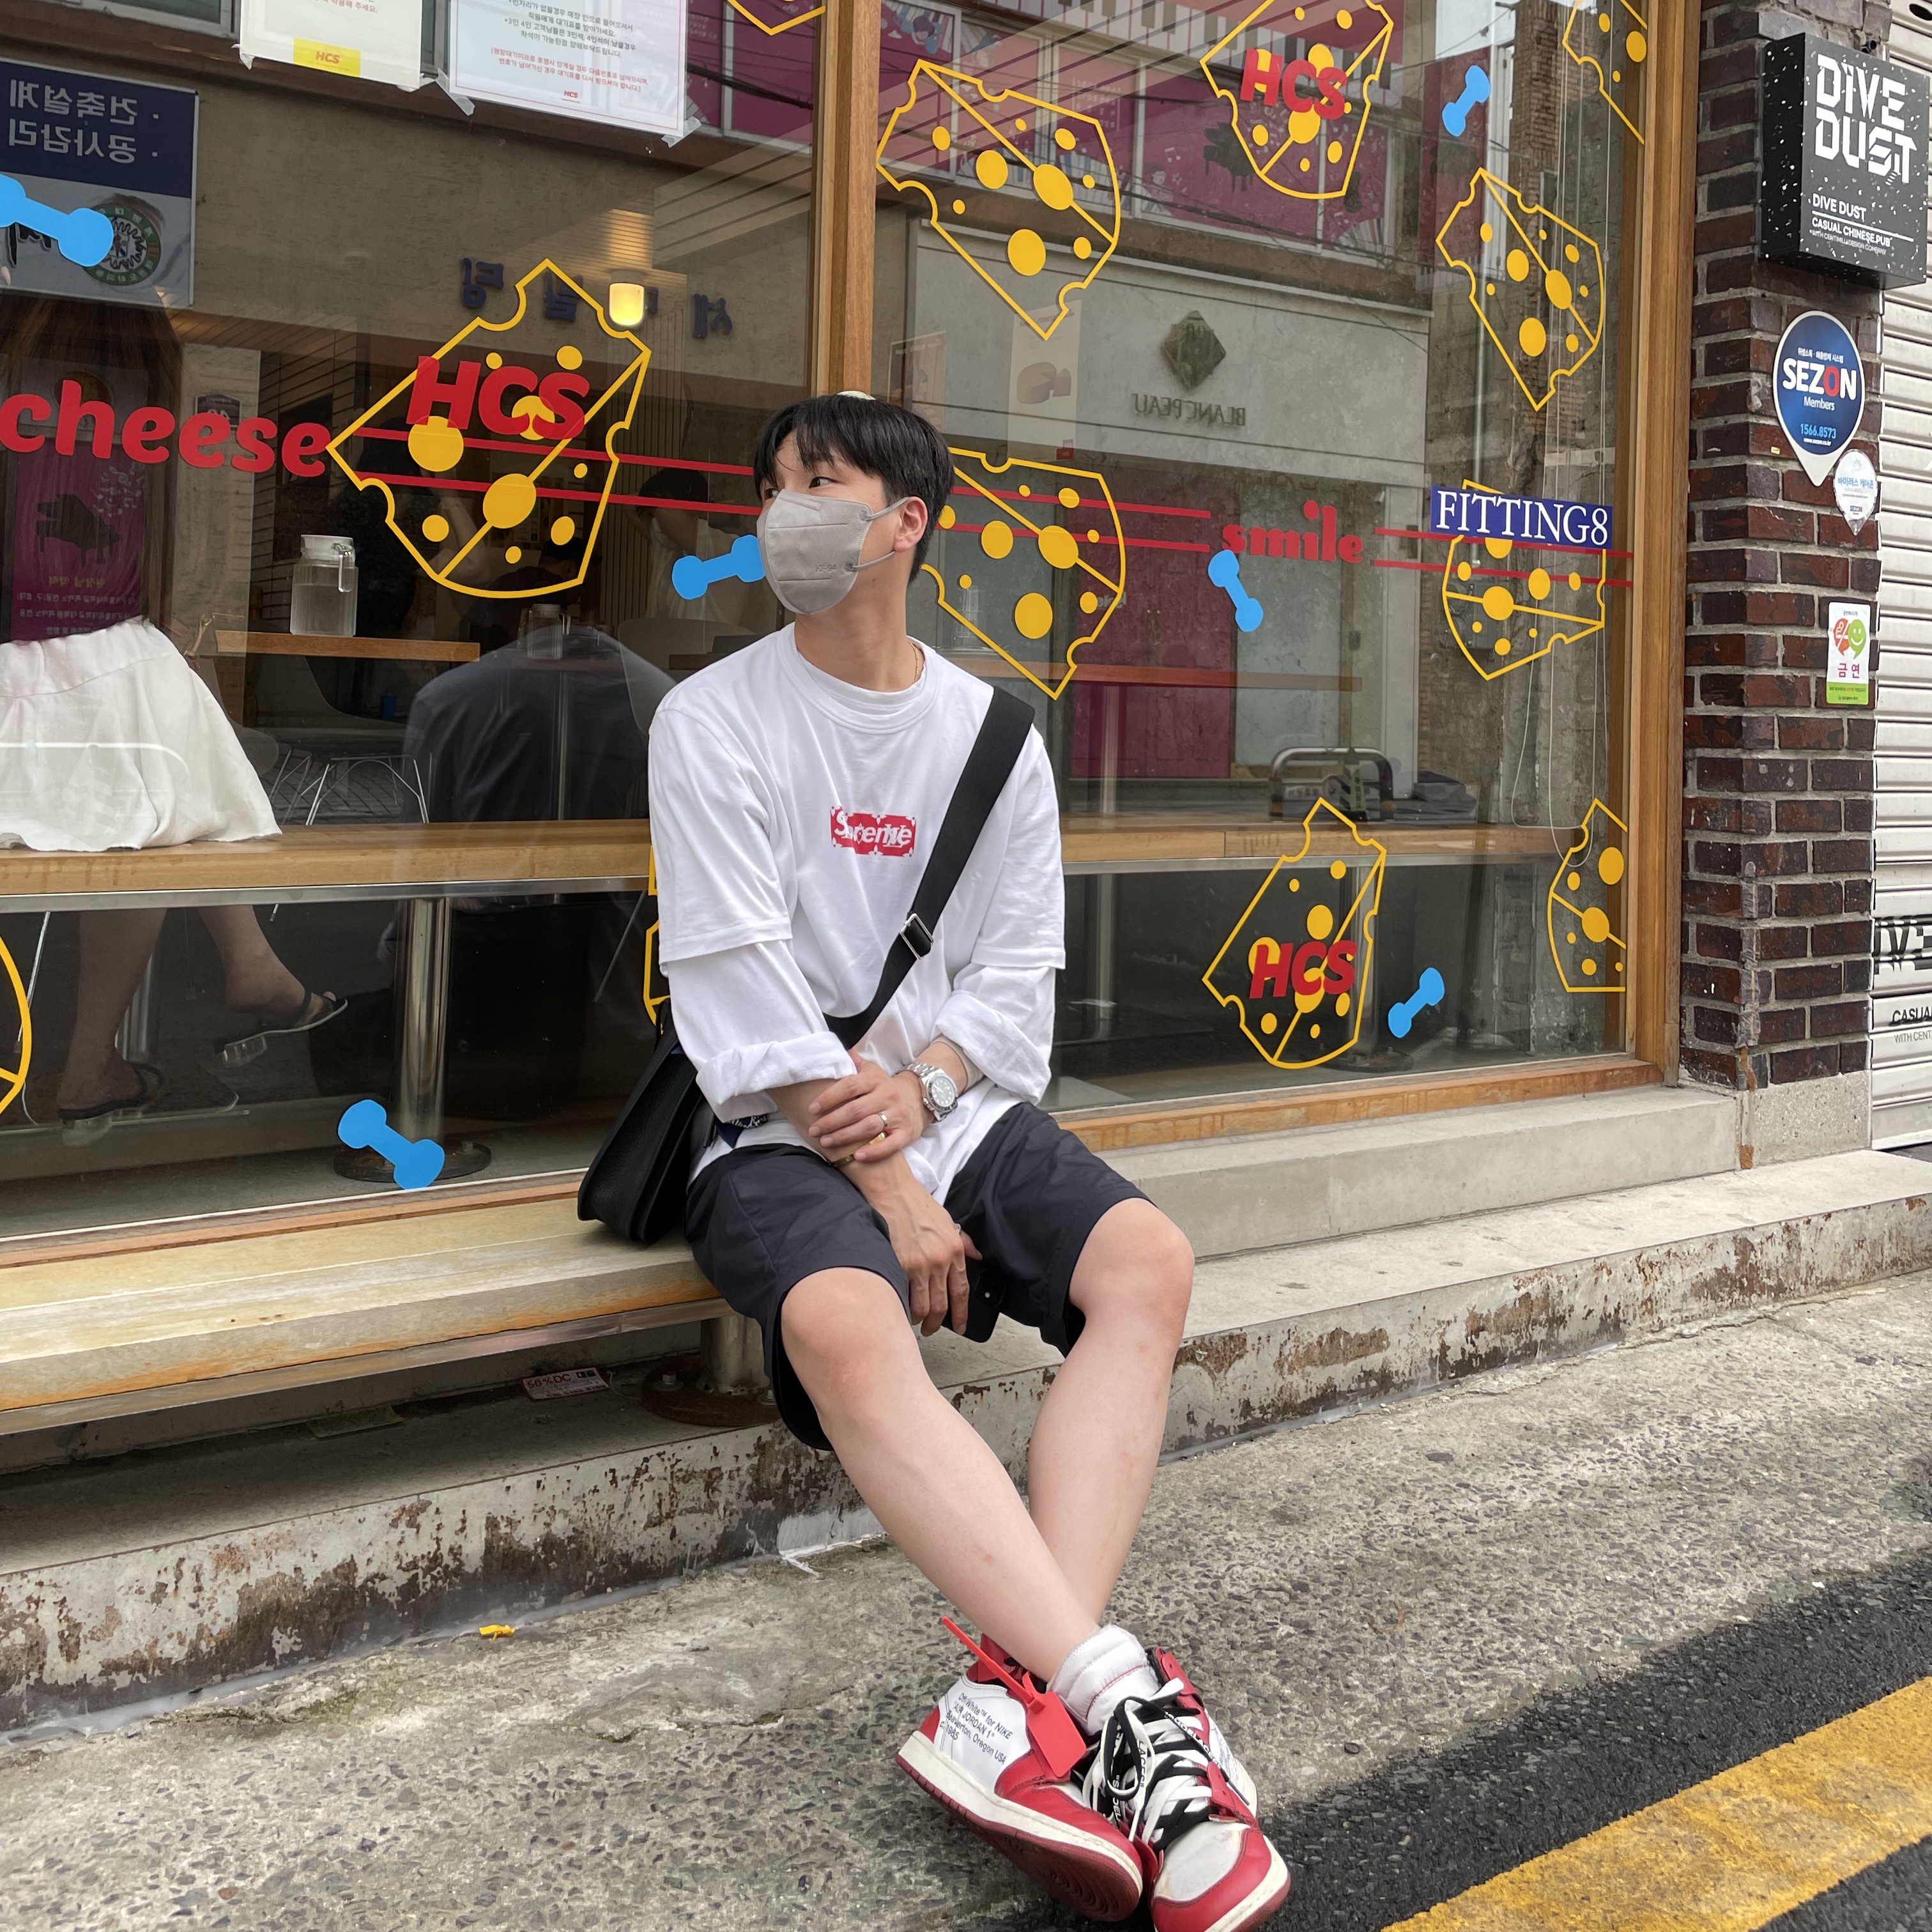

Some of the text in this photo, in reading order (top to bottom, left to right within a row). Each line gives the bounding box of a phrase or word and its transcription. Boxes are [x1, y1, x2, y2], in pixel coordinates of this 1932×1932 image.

[528, 12, 554, 24] 직원에게
[556, 18, 581, 30] 대기표를
[540, 4, 565, 15] 없을경우
[567, 11, 581, 20] 매장
[582, 14, 601, 24] 안으로
[521, 30, 540, 40] 착석이
[542, 34, 567, 47] 가능한점
[533, 24, 565, 36] 고객님들은
[587, 36, 610, 45] 4인석이
[315, 51, 341, 65] HCS
[498, 57, 517, 66] 번호가
[544, 66, 556, 75] 경우
[557, 70, 580, 80] 대기표를
[582, 75, 594, 83] 다시
[564, 90, 578, 98] HCS
[1240, 47, 1348, 121] HCS
[1816, 54, 1905, 132] DIVE
[1814, 106, 1917, 184] DUST
[1813, 193, 1867, 222] DIVE DUST
[1812, 217, 1843, 234] CASUAL
[1782, 358, 1857, 401] SEZON
[406, 356, 590, 440] HCS
[1804, 396, 1836, 411] Members
[0, 379, 332, 477] cheese
[1800, 423, 1837, 439] 1566.8573
[1436, 489, 1609, 546] FITTING8
[1222, 500, 1364, 564] smile
[1249, 939, 1357, 999] HCS
[1892, 1006, 1932, 1023] CASUA
[1894, 1032, 1912, 1043] WITH
[962, 1712, 987, 1735] JORDAN
[985, 1715, 996, 1726] for
[995, 1721, 1013, 1740] NIKE
[972, 1733, 995, 1756] Oregon
[994, 1749, 1007, 1765] USA
